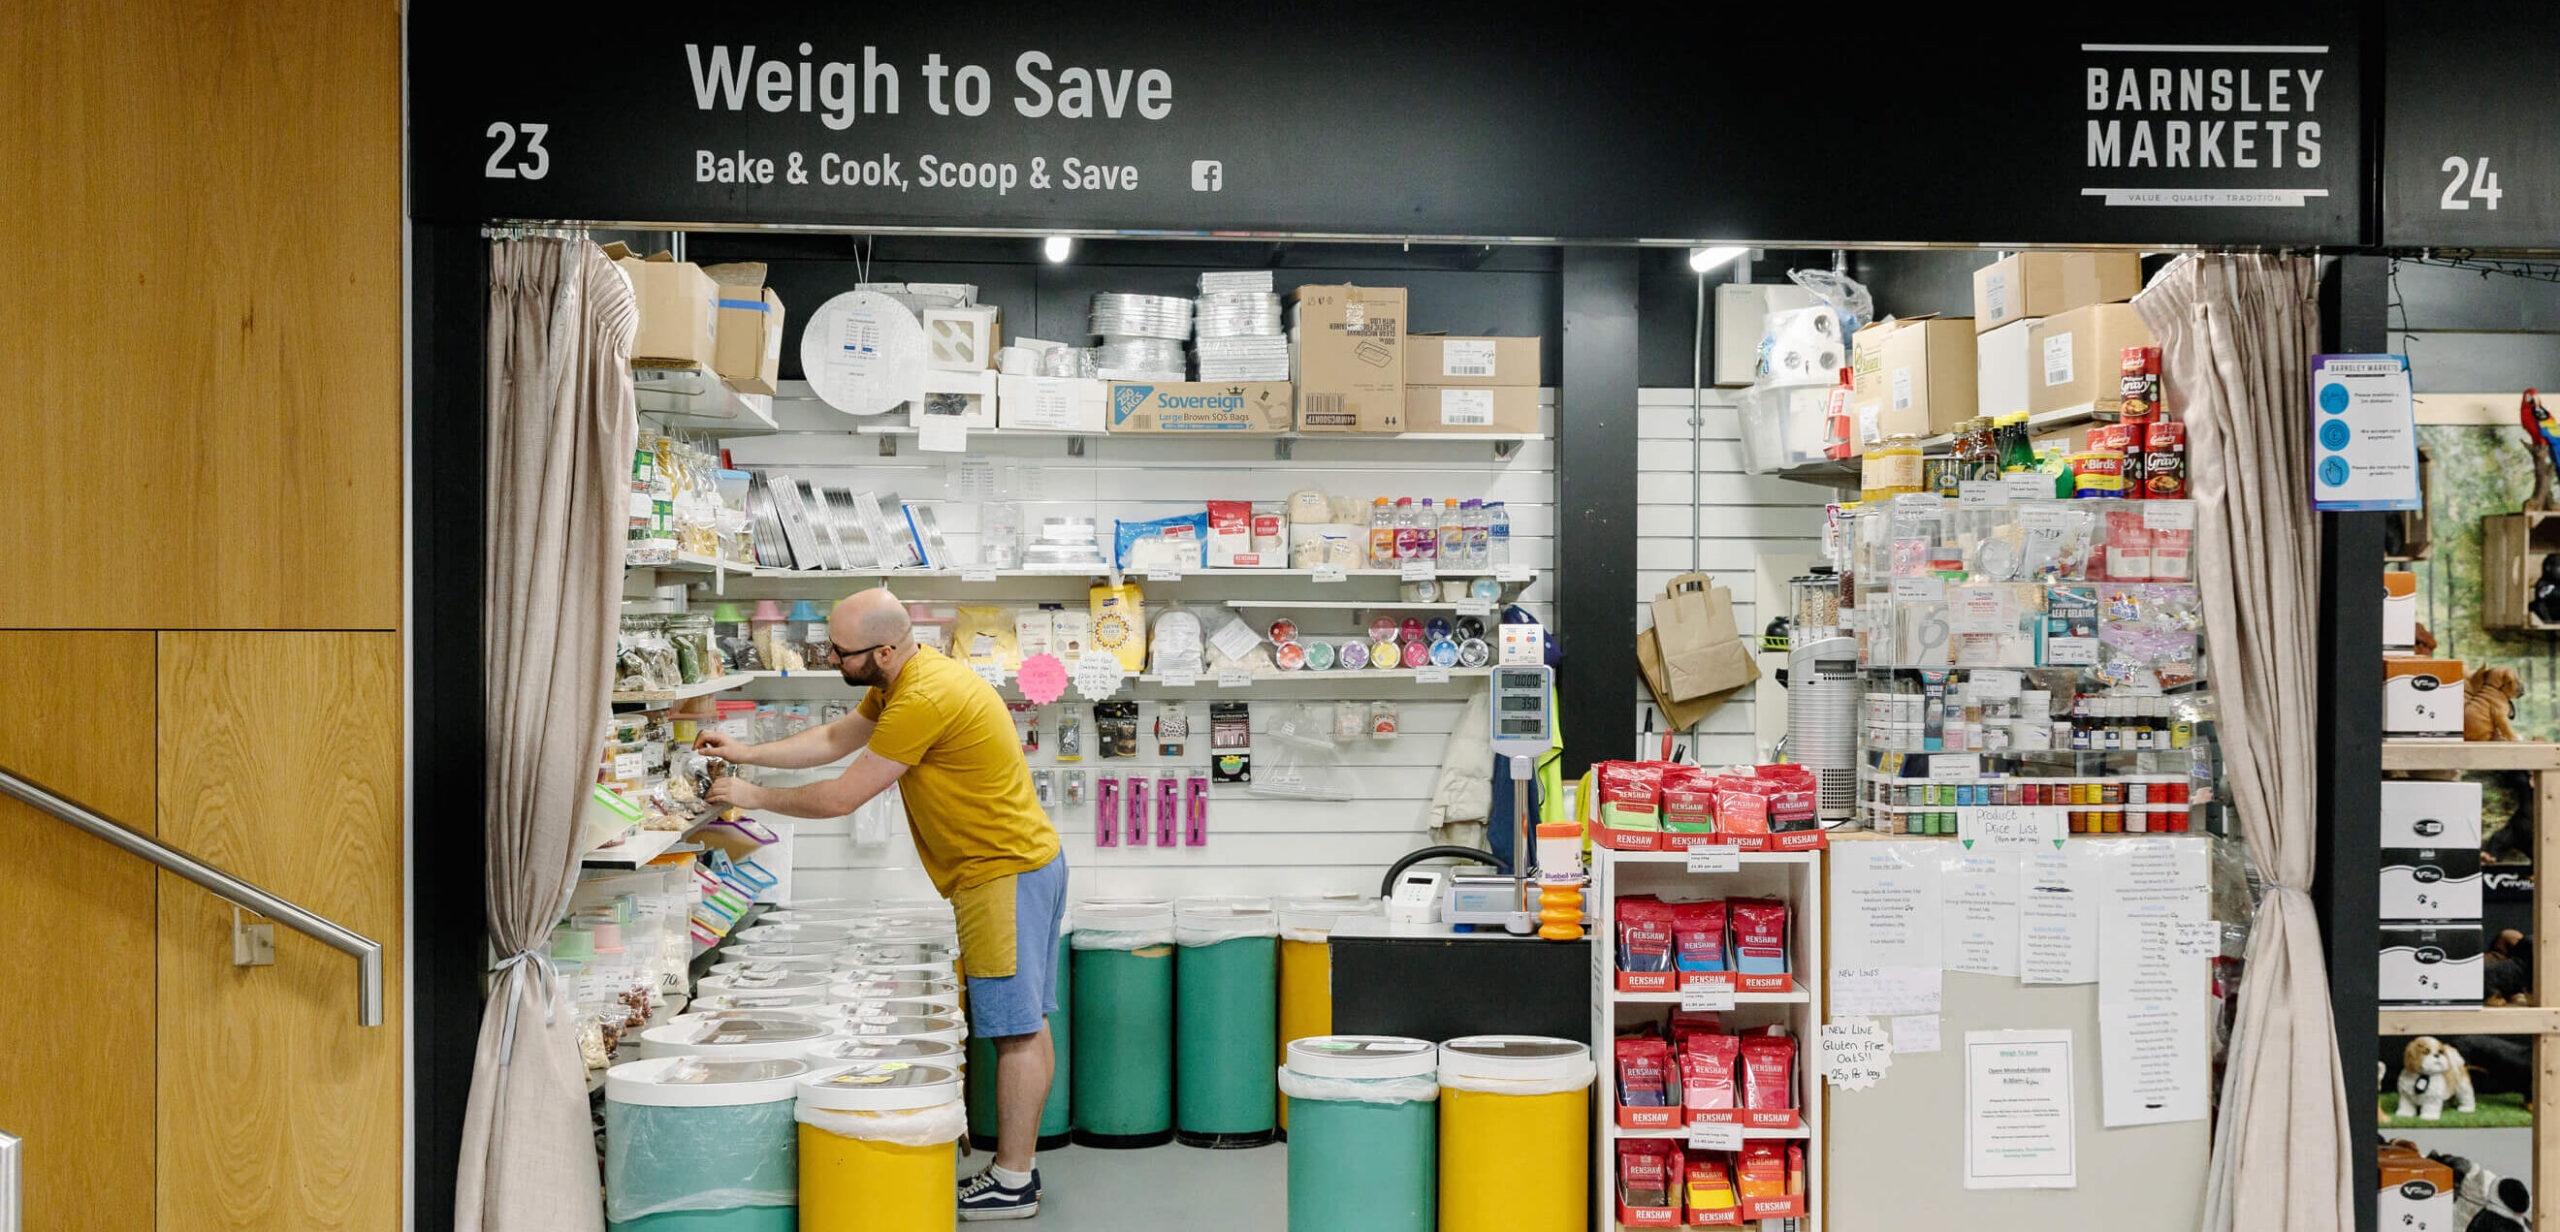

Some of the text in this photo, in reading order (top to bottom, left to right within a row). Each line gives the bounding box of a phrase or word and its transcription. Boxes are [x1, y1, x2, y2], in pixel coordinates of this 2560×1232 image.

[685, 42, 1173, 130] Weigh to Save
[2086, 67, 2324, 112] BARNSLEY
[2086, 119, 2322, 169] MARKETS
[484, 120, 551, 180] 23
[695, 150, 1139, 195] Bake & Cook, Scoop & Save
[2440, 156, 2503, 211] 24
[2128, 193, 2161, 203] VALUE
[2171, 193, 2215, 203] QUALITY
[2330, 364, 2366, 372] BARNSLEY
[2120, 377, 2151, 396] Gravy
[1157, 392, 1244, 413] Sovereign
[1159, 413, 1249, 423] Large Brown SOS Bags
[2147, 452, 2180, 471] Gravy
[1619, 791, 1652, 800] RENSHAW
[1671, 802, 1704, 812] RENSHAW
[1776, 800, 1809, 810] RENSHAW
[1976, 808, 2018, 824] Product
[1985, 822, 2039, 836] Price List
[1616, 833, 1652, 845] RENSHAW
[1672, 836, 1708, 846] RENSHAW
[1727, 837, 1763, 847] RENSHAW
[1782, 834, 1818, 845] RENSHAW
[1632, 931, 1665, 941] RENSHAW
[1745, 935, 1778, 945] RENSHAW
[1684, 941, 1717, 950] RENSHAW
[1838, 969, 1855, 978] NEW
[1629, 976, 1665, 986] RENSHAW
[1689, 975, 1726, 985] RENSHAW
[1746, 977, 1782, 987] RENSHAW
[1828, 1024, 1873, 1035] NEW LINE
[1822, 1040, 1885, 1051] Gluten Free
[1627, 1067, 1660, 1077] RENSHAW
[1695, 1065, 1728, 1075] RENSHAW
[1751, 1064, 1783, 1074] RENSHAW
[1632, 1113, 1669, 1123] RENSHAW
[1696, 1112, 1733, 1122] RENSHAW
[1752, 1113, 1790, 1123] RENSHAW
[1630, 1165, 1662, 1175] RENSHAW
[1692, 1170, 1723, 1179] RENSHAW
[1754, 1201, 1791, 1212] RENSHAW
[1635, 1210, 1672, 1220] RENSHAW
[1699, 1211, 1735, 1222] RENSHAW
